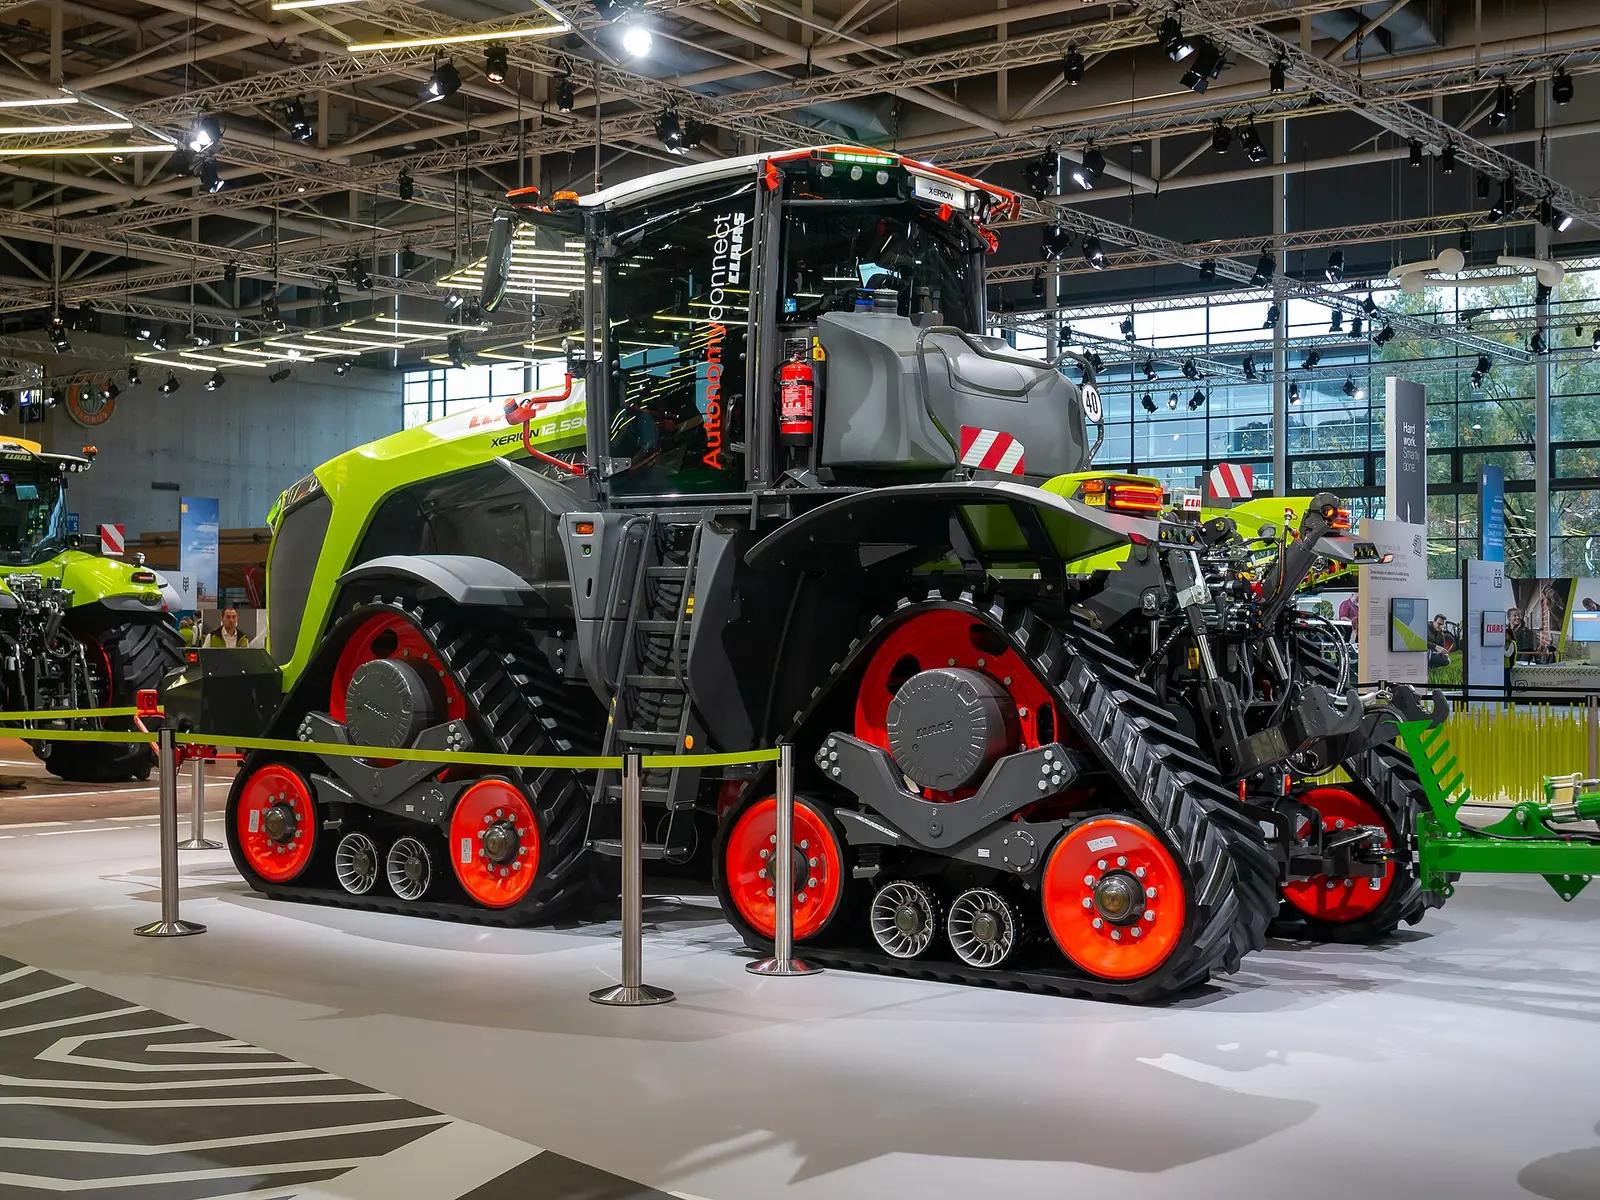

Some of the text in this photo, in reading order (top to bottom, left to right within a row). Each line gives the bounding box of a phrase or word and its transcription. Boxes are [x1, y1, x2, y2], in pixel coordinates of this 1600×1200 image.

[928, 186, 954, 201] XERION
[728, 212, 745, 284] CLAAS
[1086, 391, 1098, 414] 40
[1402, 421, 1415, 435] Hard
[4, 453, 32, 461] CLAAS
[1486, 624, 1503, 633] CLAAS
[916, 720, 954, 739] CLAAS
